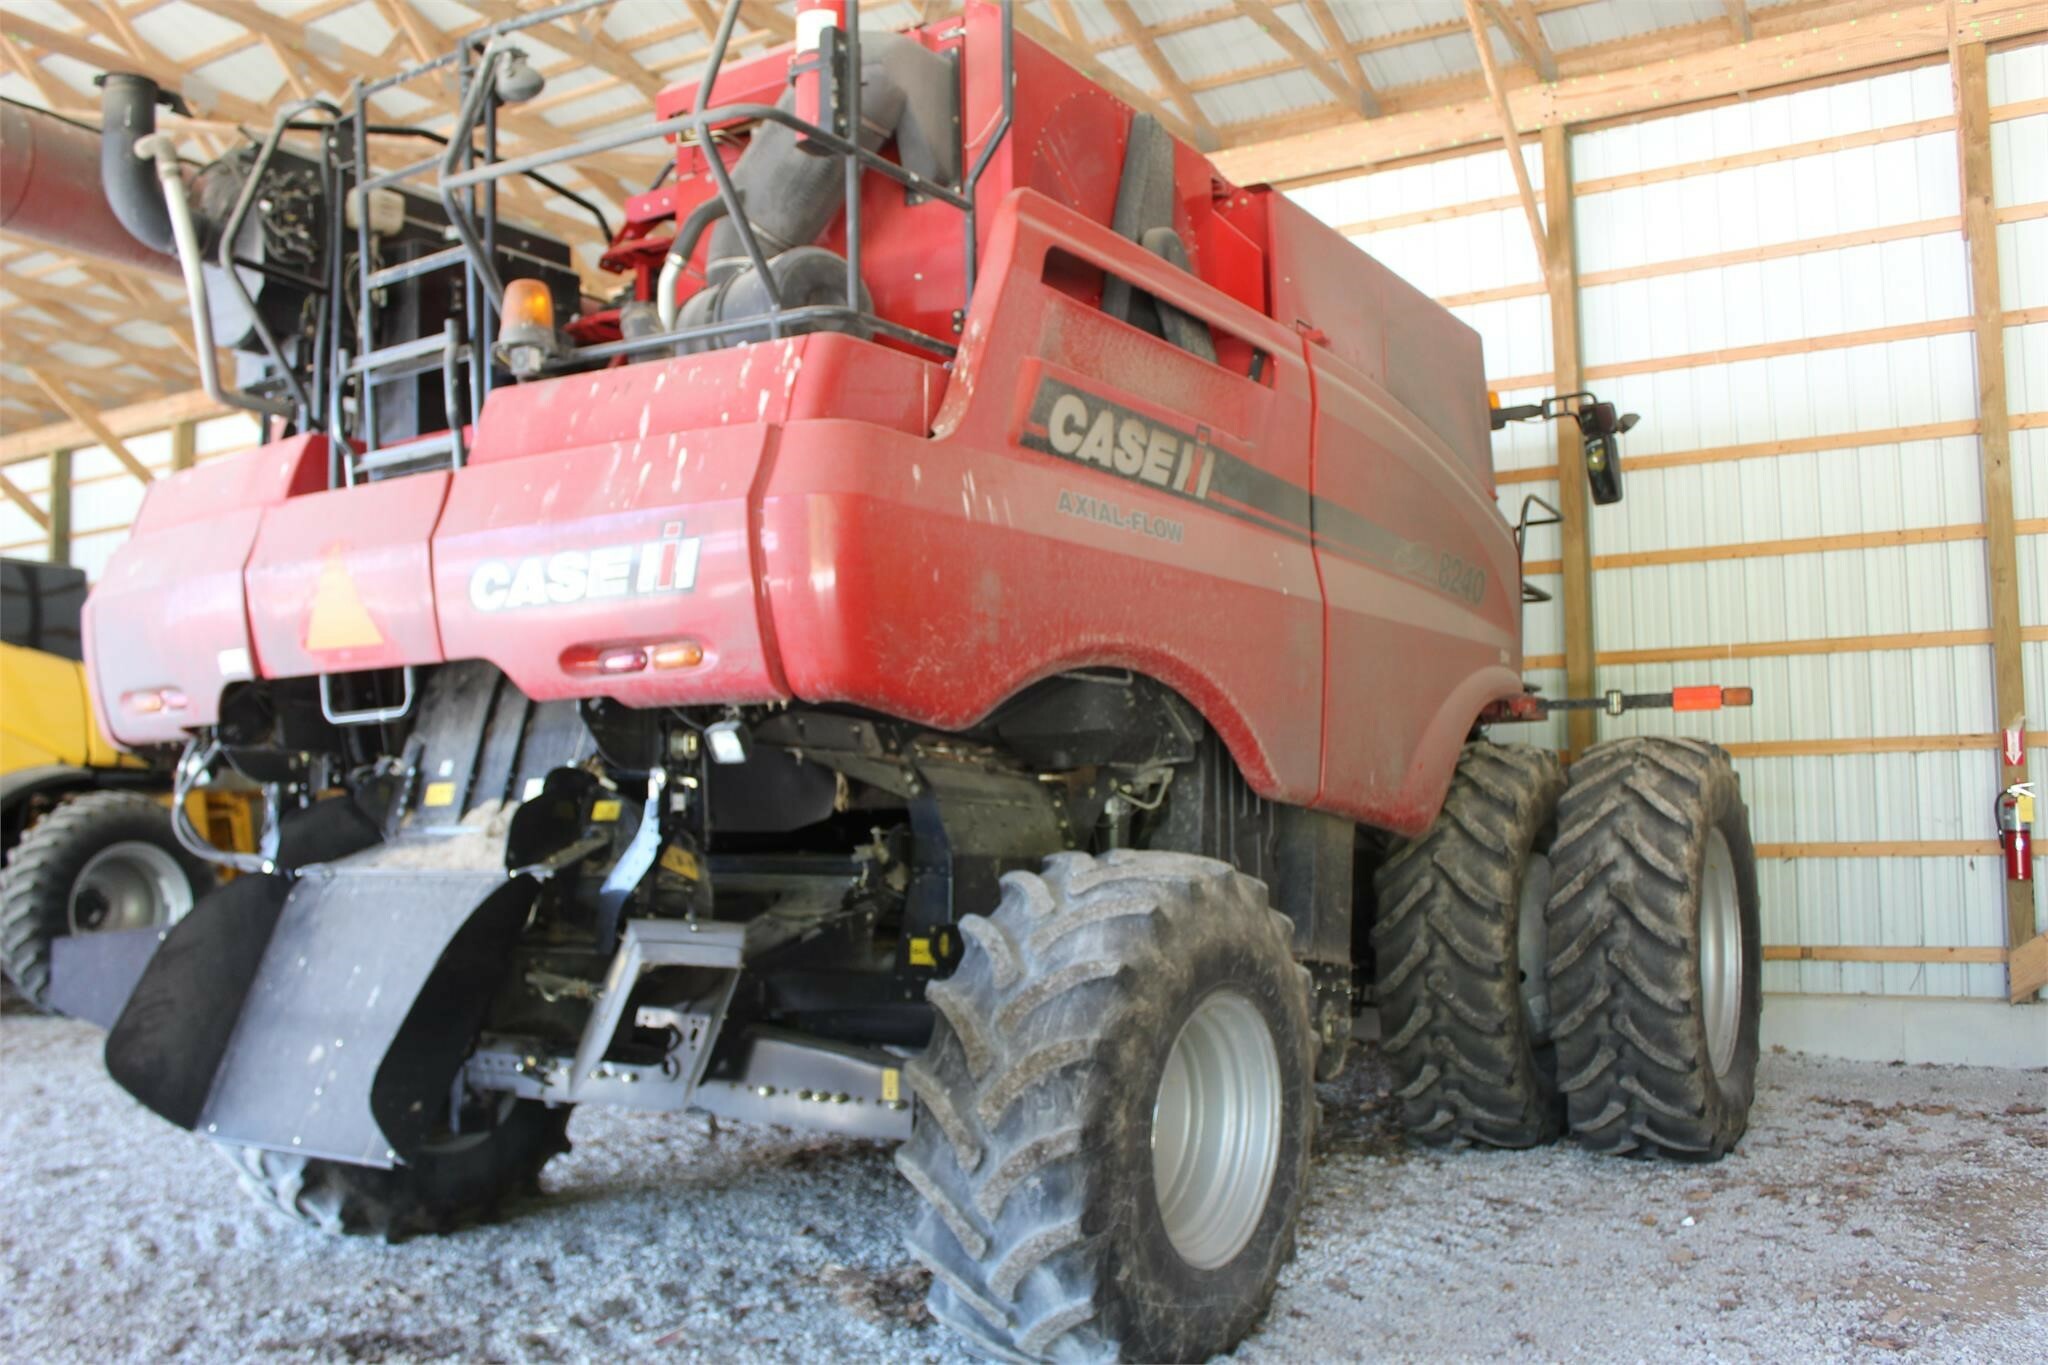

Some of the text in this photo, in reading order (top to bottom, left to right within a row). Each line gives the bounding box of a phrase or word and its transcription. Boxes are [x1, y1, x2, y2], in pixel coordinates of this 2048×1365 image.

[1049, 394, 1178, 486] CASE
[1057, 488, 1184, 544] AXIAL-FLOW
[470, 544, 634, 611] CASE
[1439, 548, 1487, 606] 8240
